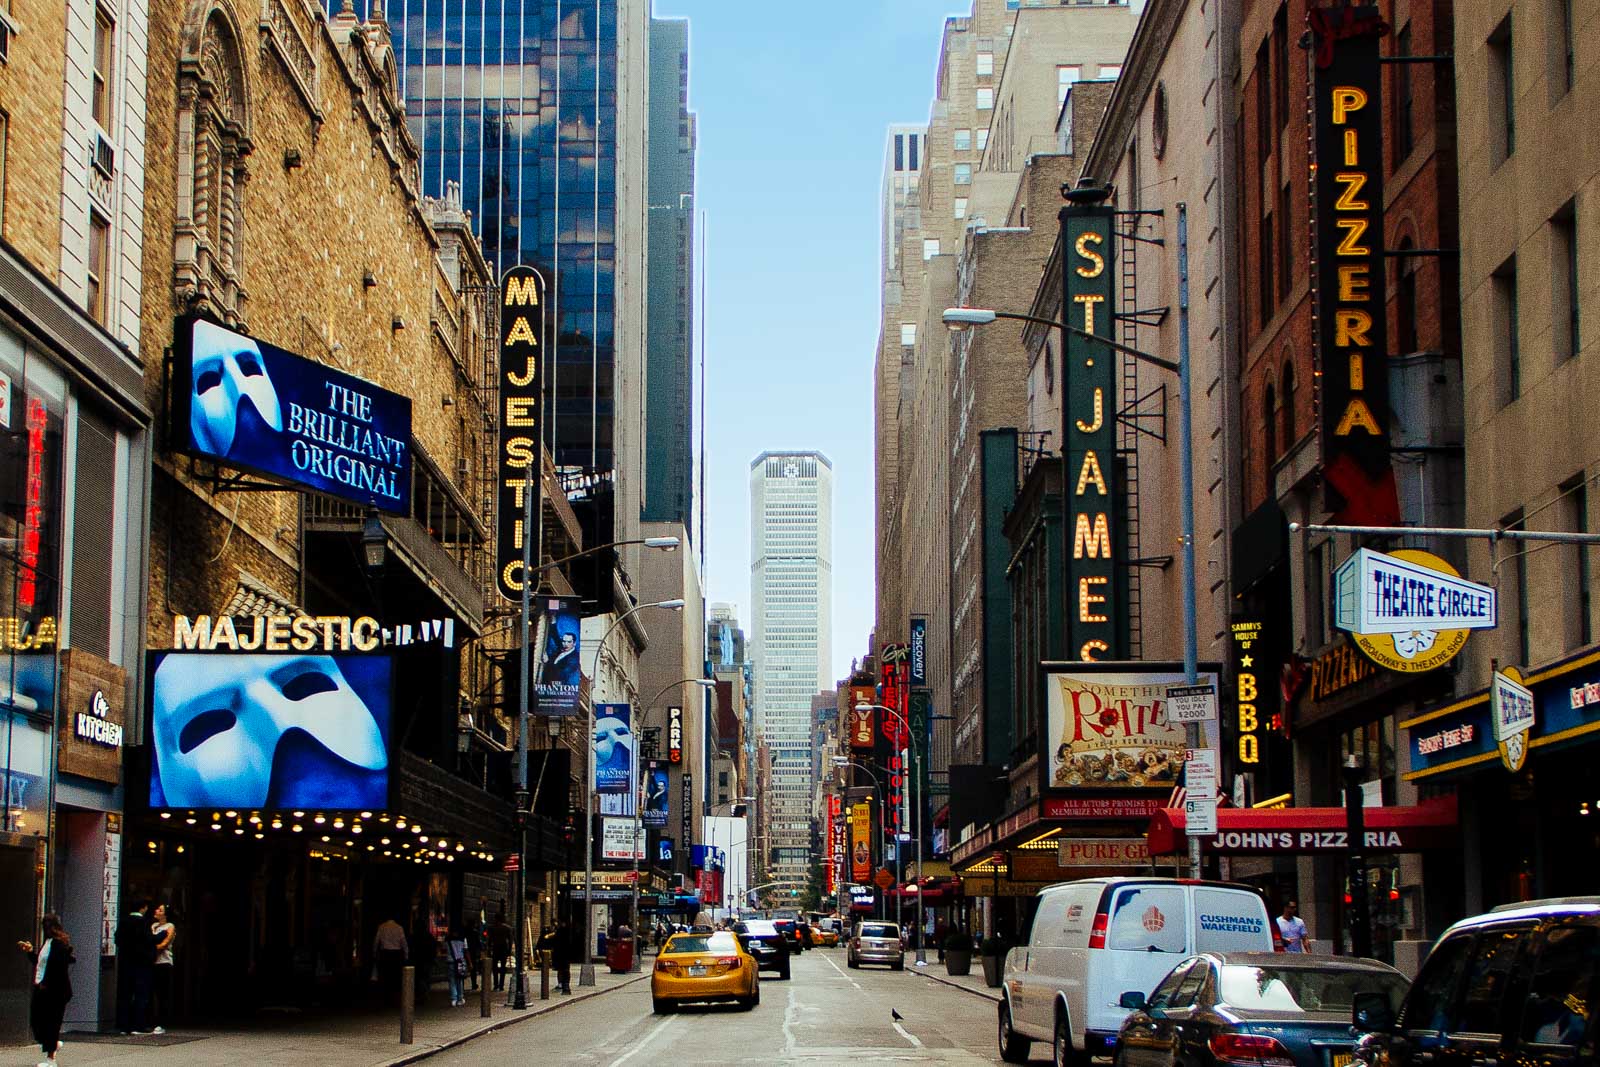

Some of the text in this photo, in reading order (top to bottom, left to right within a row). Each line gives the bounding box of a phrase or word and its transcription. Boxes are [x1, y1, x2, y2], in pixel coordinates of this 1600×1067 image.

[1332, 86, 1382, 436] PIZZERIA
[325, 381, 373, 423] THE
[288, 402, 405, 468] BRILLIANT
[503, 276, 538, 591] MAJESTIC
[292, 440, 401, 500] ORIGINAL
[1375, 570, 1487, 617] THEATRE CIRCLE
[174, 615, 380, 651] MAJESTIC
[1235, 632, 1258, 640] HOUSE
[1242, 641, 1252, 649] OF
[1410, 650, 1447, 671] THEATRE
[1447, 631, 1465, 653] SHOP
[534, 684, 579, 693] PHANTOM
[1176, 703, 1191, 711] YOU
[1178, 710, 1206, 719] $2000
[1238, 673, 1259, 764] BBQ
[78, 713, 123, 746] KITCHEN
[671, 708, 681, 749] PARK
[1186, 751, 1193, 761] 3
[1112, 800, 1145, 808] PROMISE
[1147, 800, 1158, 808] TO
[1187, 802, 1194, 812] 6
[1051, 808, 1090, 817] MEMORIZE
[1092, 808, 1113, 816] MOST
[1114, 808, 1123, 816] OF
[1212, 831, 1402, 848] JOHN'S PIZZRIA
[1070, 844, 1121, 859] PURE
[1200, 914, 1255, 925] CUSHMAN
[1201, 922, 1261, 933] WAKEFIELD
